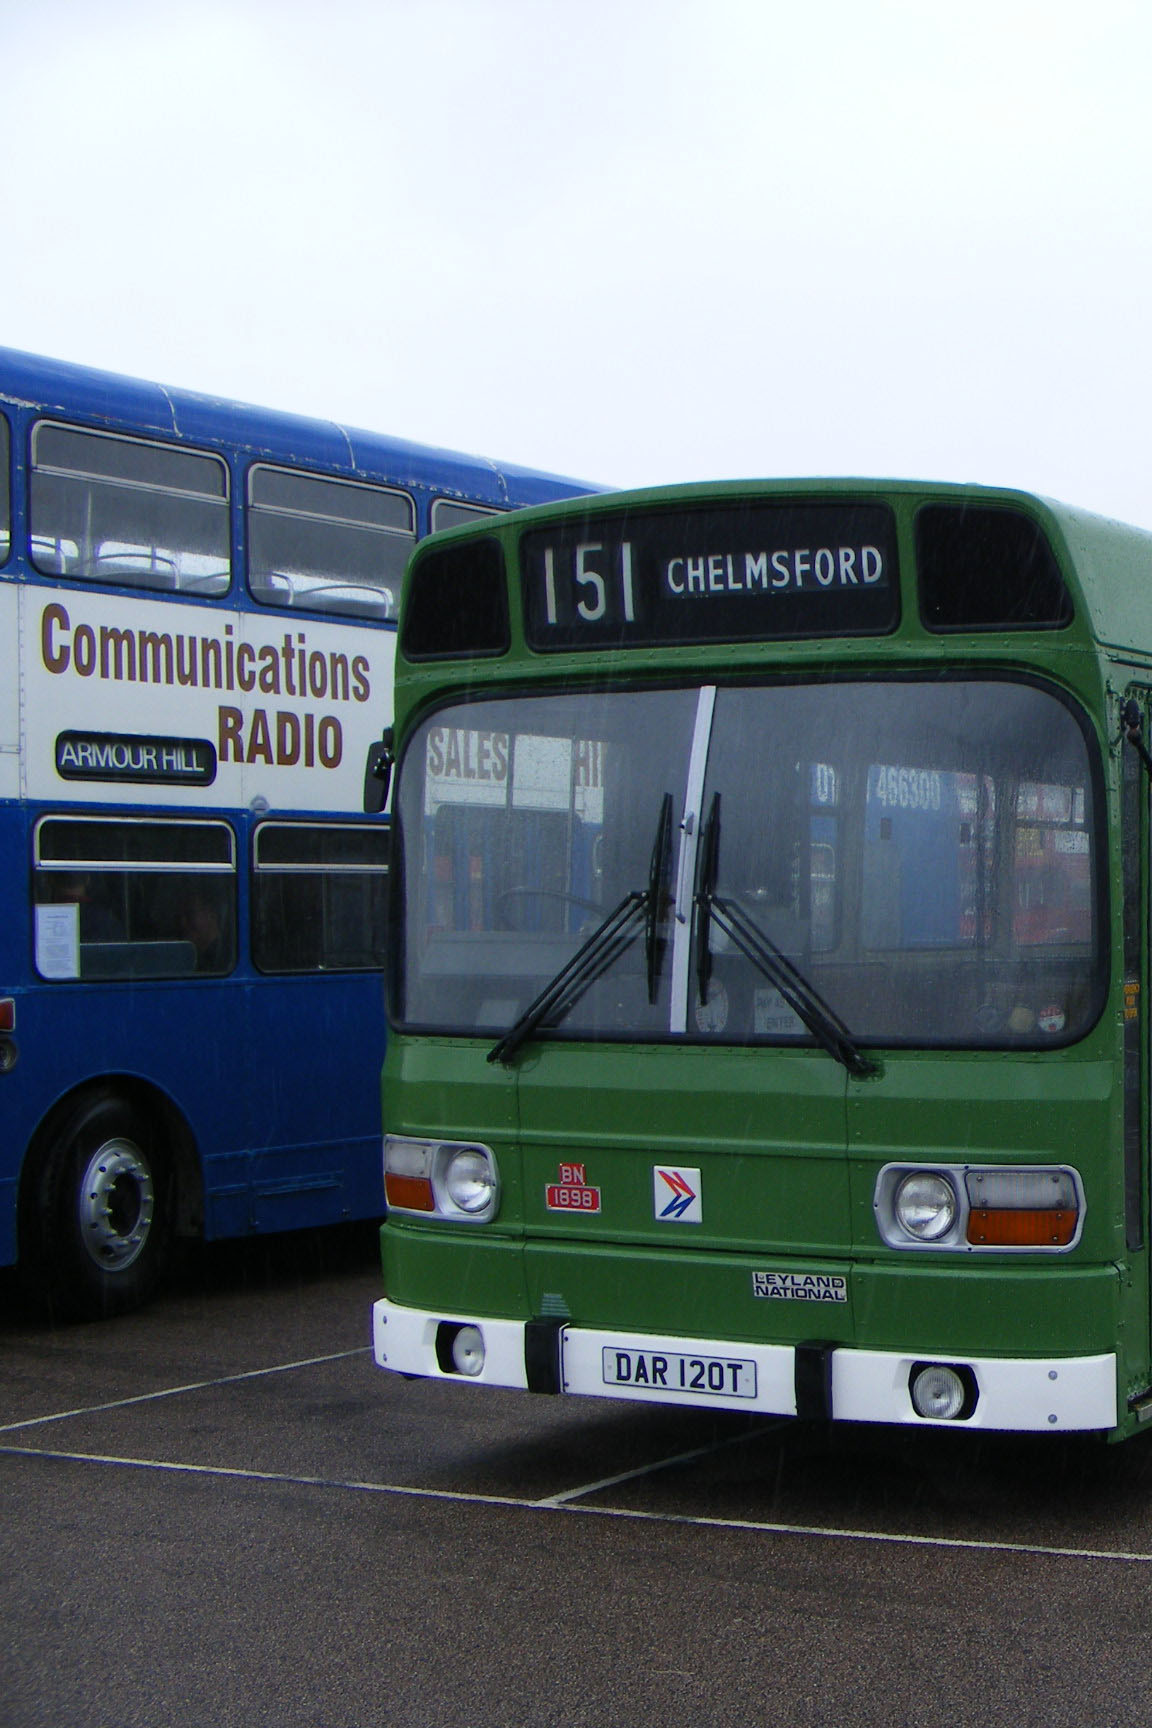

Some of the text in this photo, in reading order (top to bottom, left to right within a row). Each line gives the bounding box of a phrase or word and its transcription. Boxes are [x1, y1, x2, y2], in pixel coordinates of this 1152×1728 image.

[545, 541, 883, 623] 151 CHELMSFORD
[41, 602, 370, 702] Communications
[218, 705, 343, 769] RADIO
[428, 726, 508, 782] SALES
[60, 742, 205, 772] ARMOUR HILL
[561, 1166, 584, 1184] BN
[553, 1188, 593, 1208] 1898
[754, 1273, 845, 1288] LEYLAND
[755, 1285, 846, 1301] NATIONAL
[615, 1352, 743, 1393] DAR 120T
